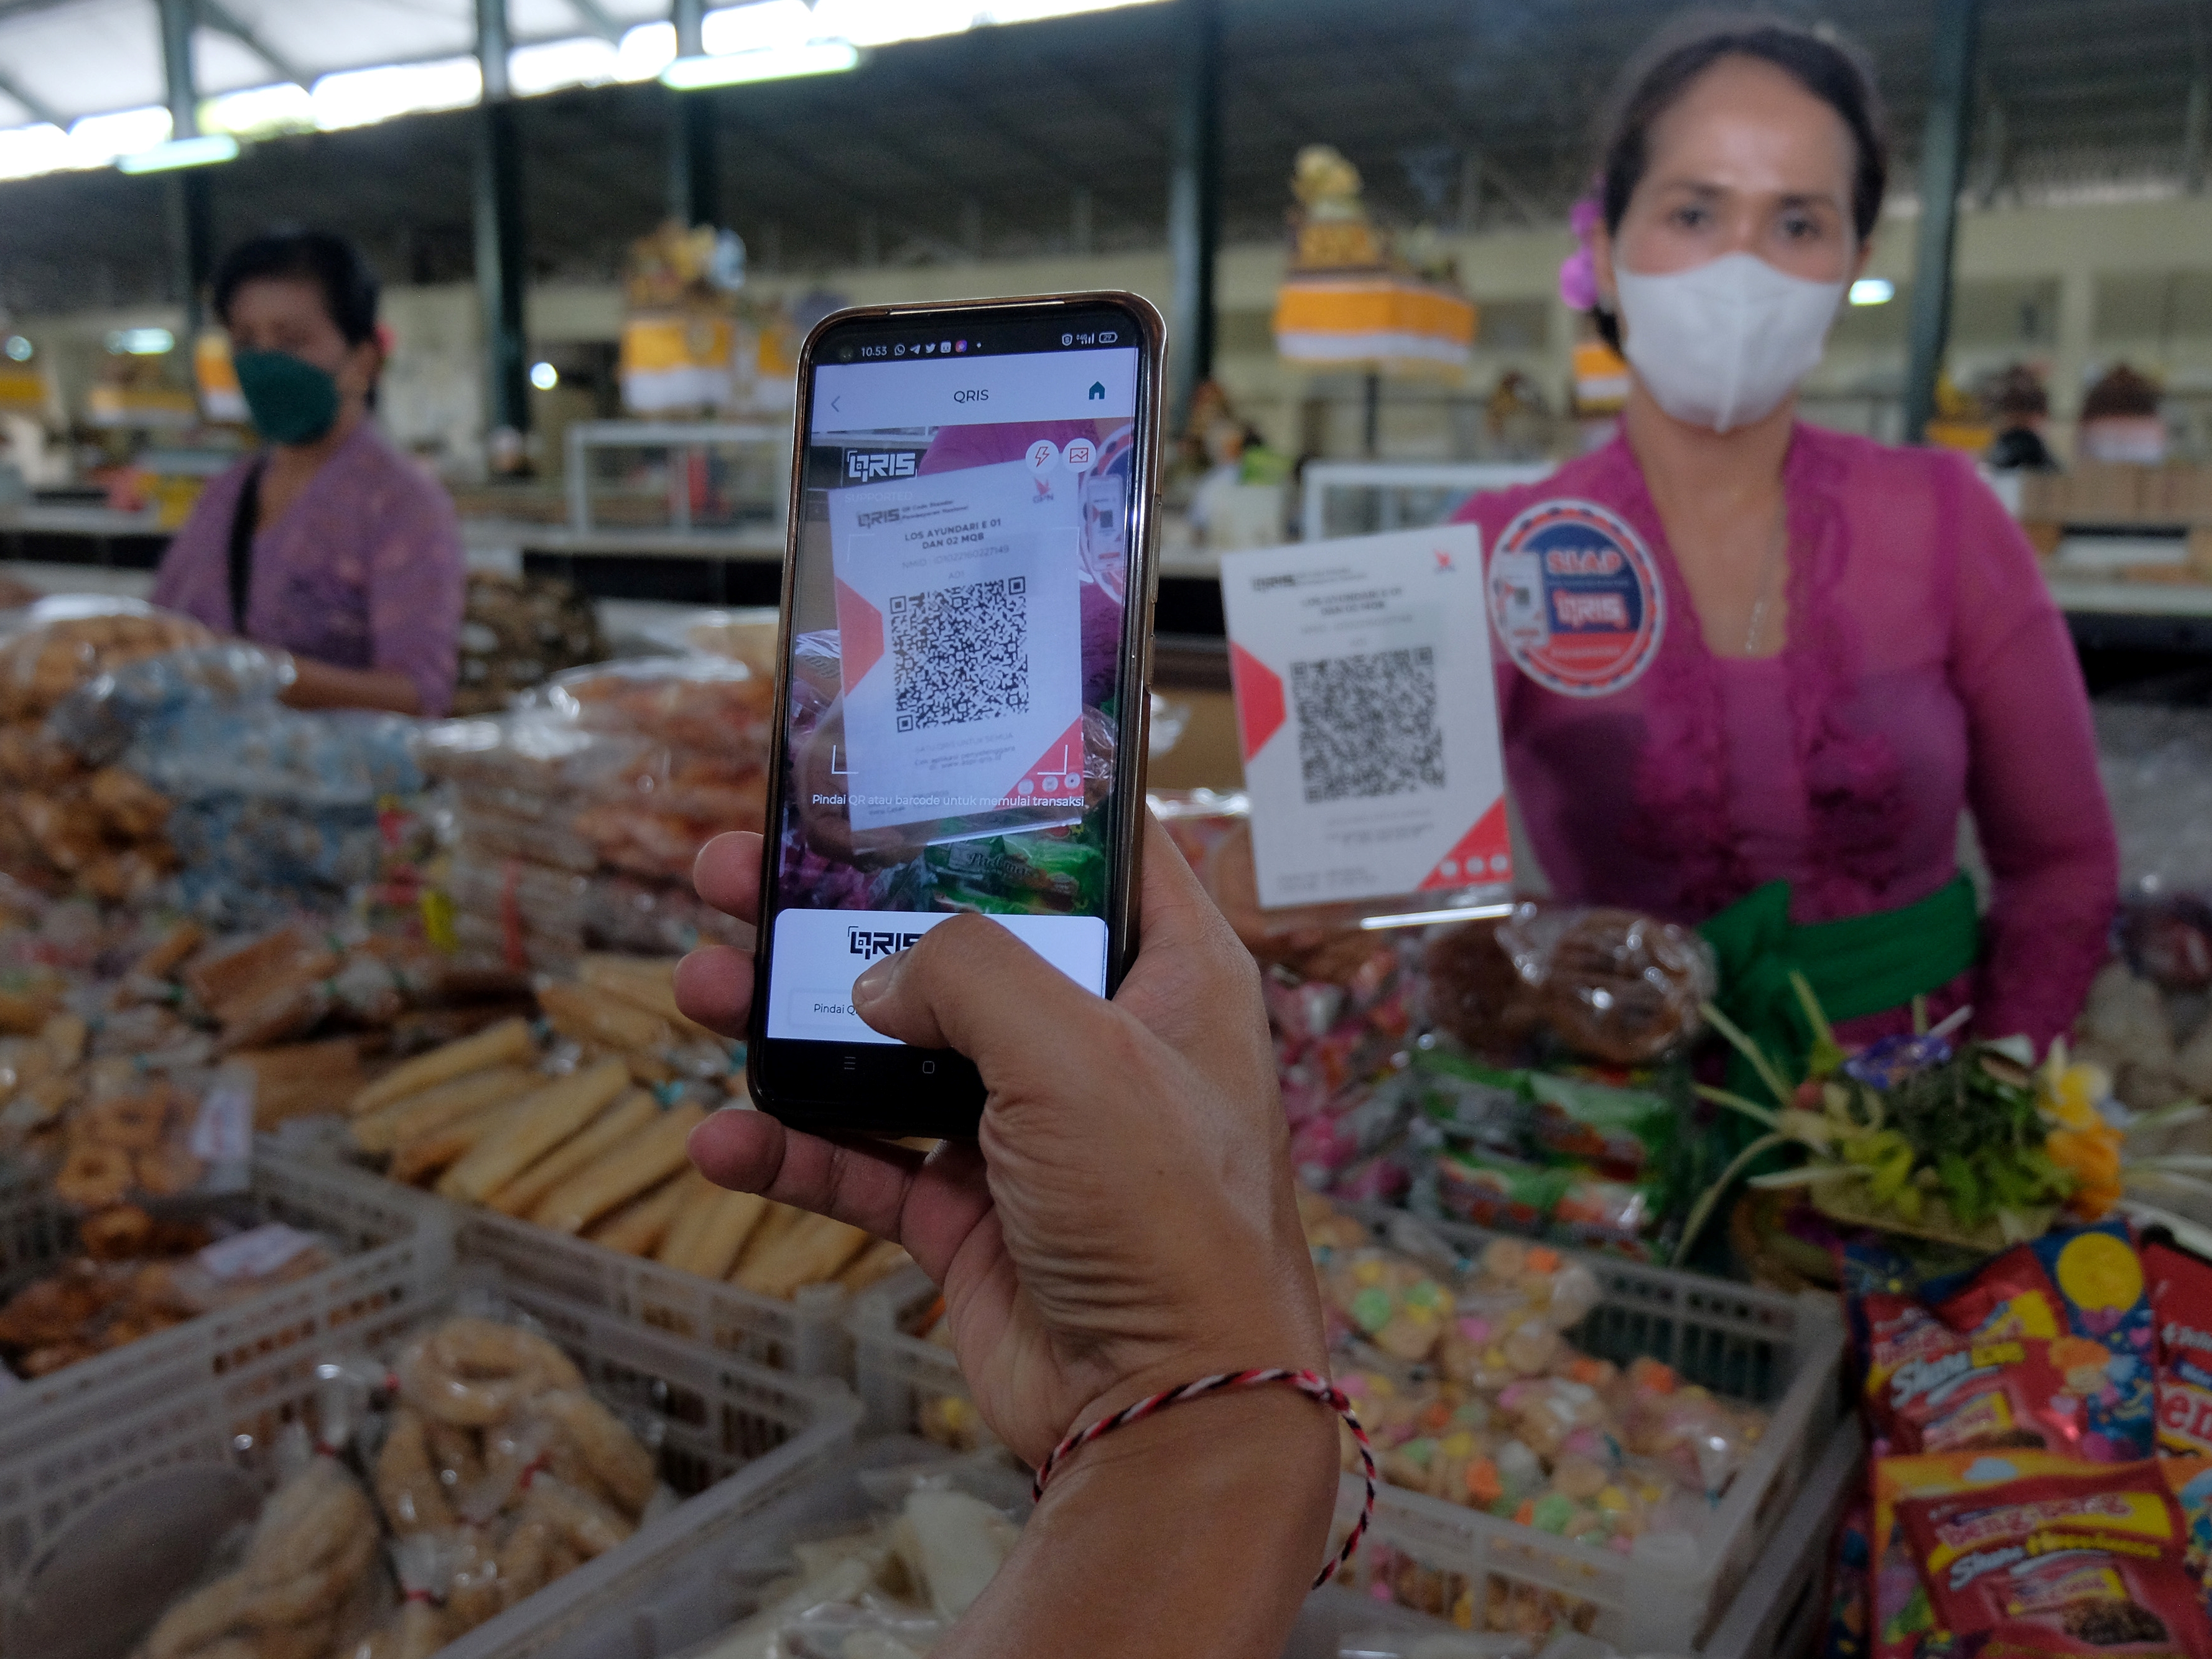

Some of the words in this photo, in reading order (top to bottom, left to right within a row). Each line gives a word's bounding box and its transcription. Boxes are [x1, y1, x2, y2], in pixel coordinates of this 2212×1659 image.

[861, 346, 888, 356] 10.53
[954, 389, 990, 404] QRIS
[848, 452, 917, 481] QRIS
[845, 491, 913, 503] SUPPORTED
[858, 508, 900, 529] QRIS
[904, 531, 924, 541] LOS
[927, 521, 979, 537] AYUNDARI
[982, 520, 987, 529] E
[990, 519, 1001, 527] 01
[922, 539, 943, 549] DAN
[946, 536, 958, 545] 02
[961, 532, 984, 543] MQB
[812, 794, 846, 804] Pindai
[848, 795, 866, 806] QR
[868, 796, 892, 805] atau
[895, 795, 940, 805] barcode
[943, 795, 977, 806] untuk
[979, 795, 1030, 806] memulai
[1033, 795, 1084, 807] transaksi
[814, 1003, 845, 1015] Pindai
[847, 1004, 858, 1016] Q
